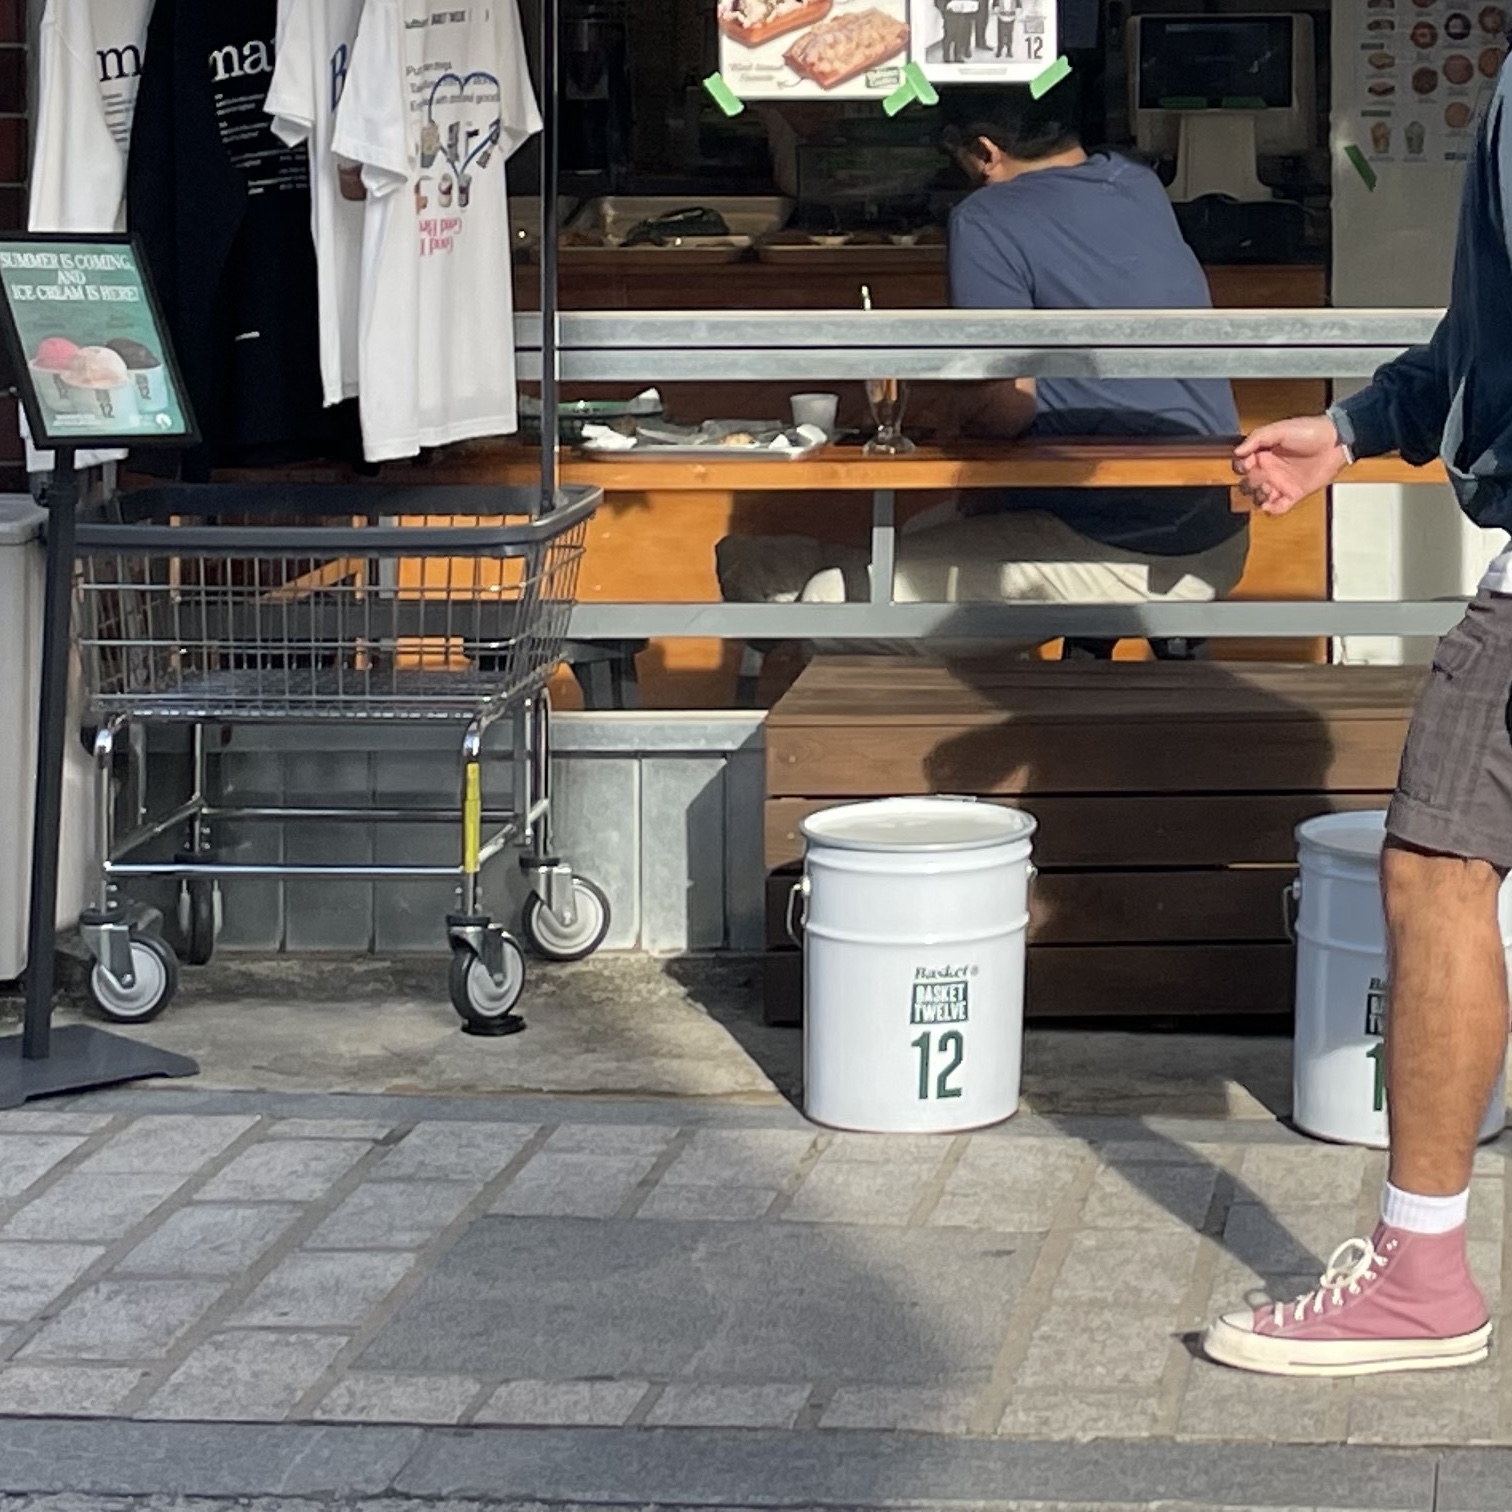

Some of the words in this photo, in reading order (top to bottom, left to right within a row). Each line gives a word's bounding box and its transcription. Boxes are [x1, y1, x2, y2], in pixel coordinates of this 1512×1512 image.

[1024, 36, 1044, 60] 12
[1, 252, 59, 269] SUMMER
[57, 270, 87, 285] AND
[11, 284, 37, 301] ICE
[37, 285, 84, 301] CREAM
[914, 964, 970, 980] Basket
[915, 983, 966, 1004] BASKET
[914, 1001, 967, 1023] TWELVE
[910, 1028, 964, 1101] 12
[1366, 1042, 1385, 1113] 1
